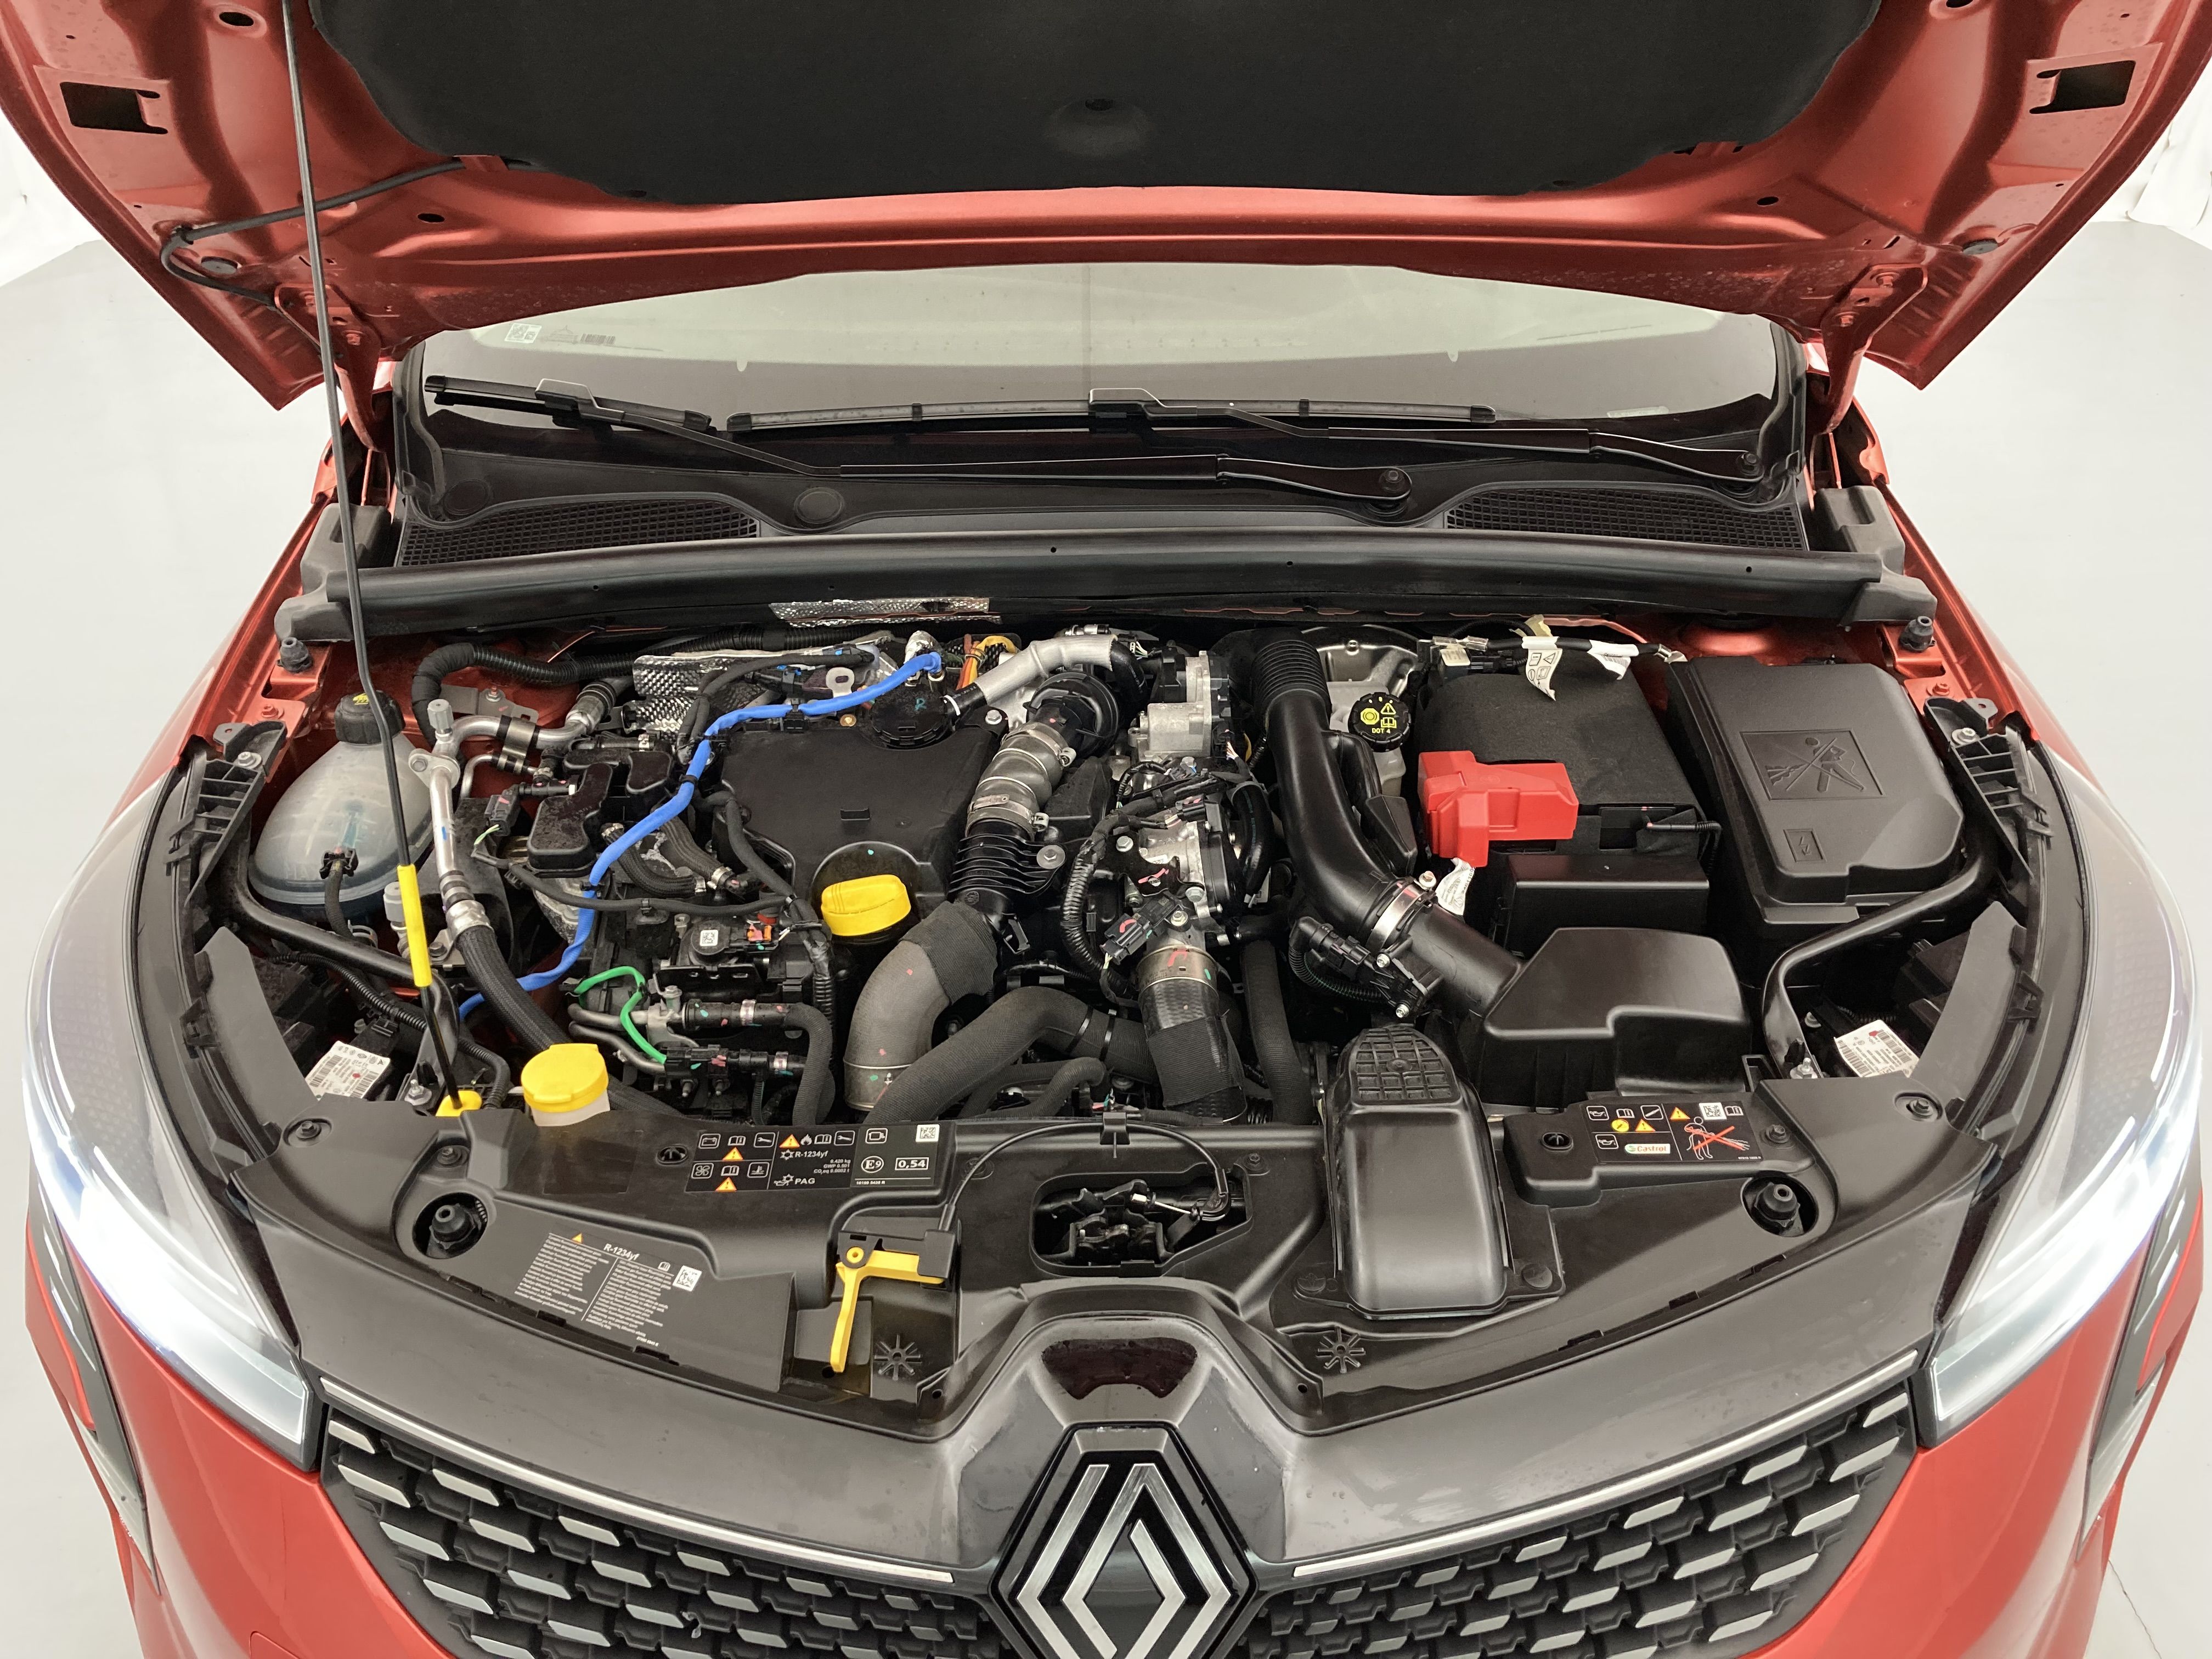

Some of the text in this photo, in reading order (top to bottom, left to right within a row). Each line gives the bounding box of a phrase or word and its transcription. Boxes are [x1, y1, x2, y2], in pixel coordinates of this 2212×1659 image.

[794, 1150, 829, 1159] R-1234yf
[898, 1159, 926, 1169] 0,54
[603, 1243, 640, 1261] R-1234yf
